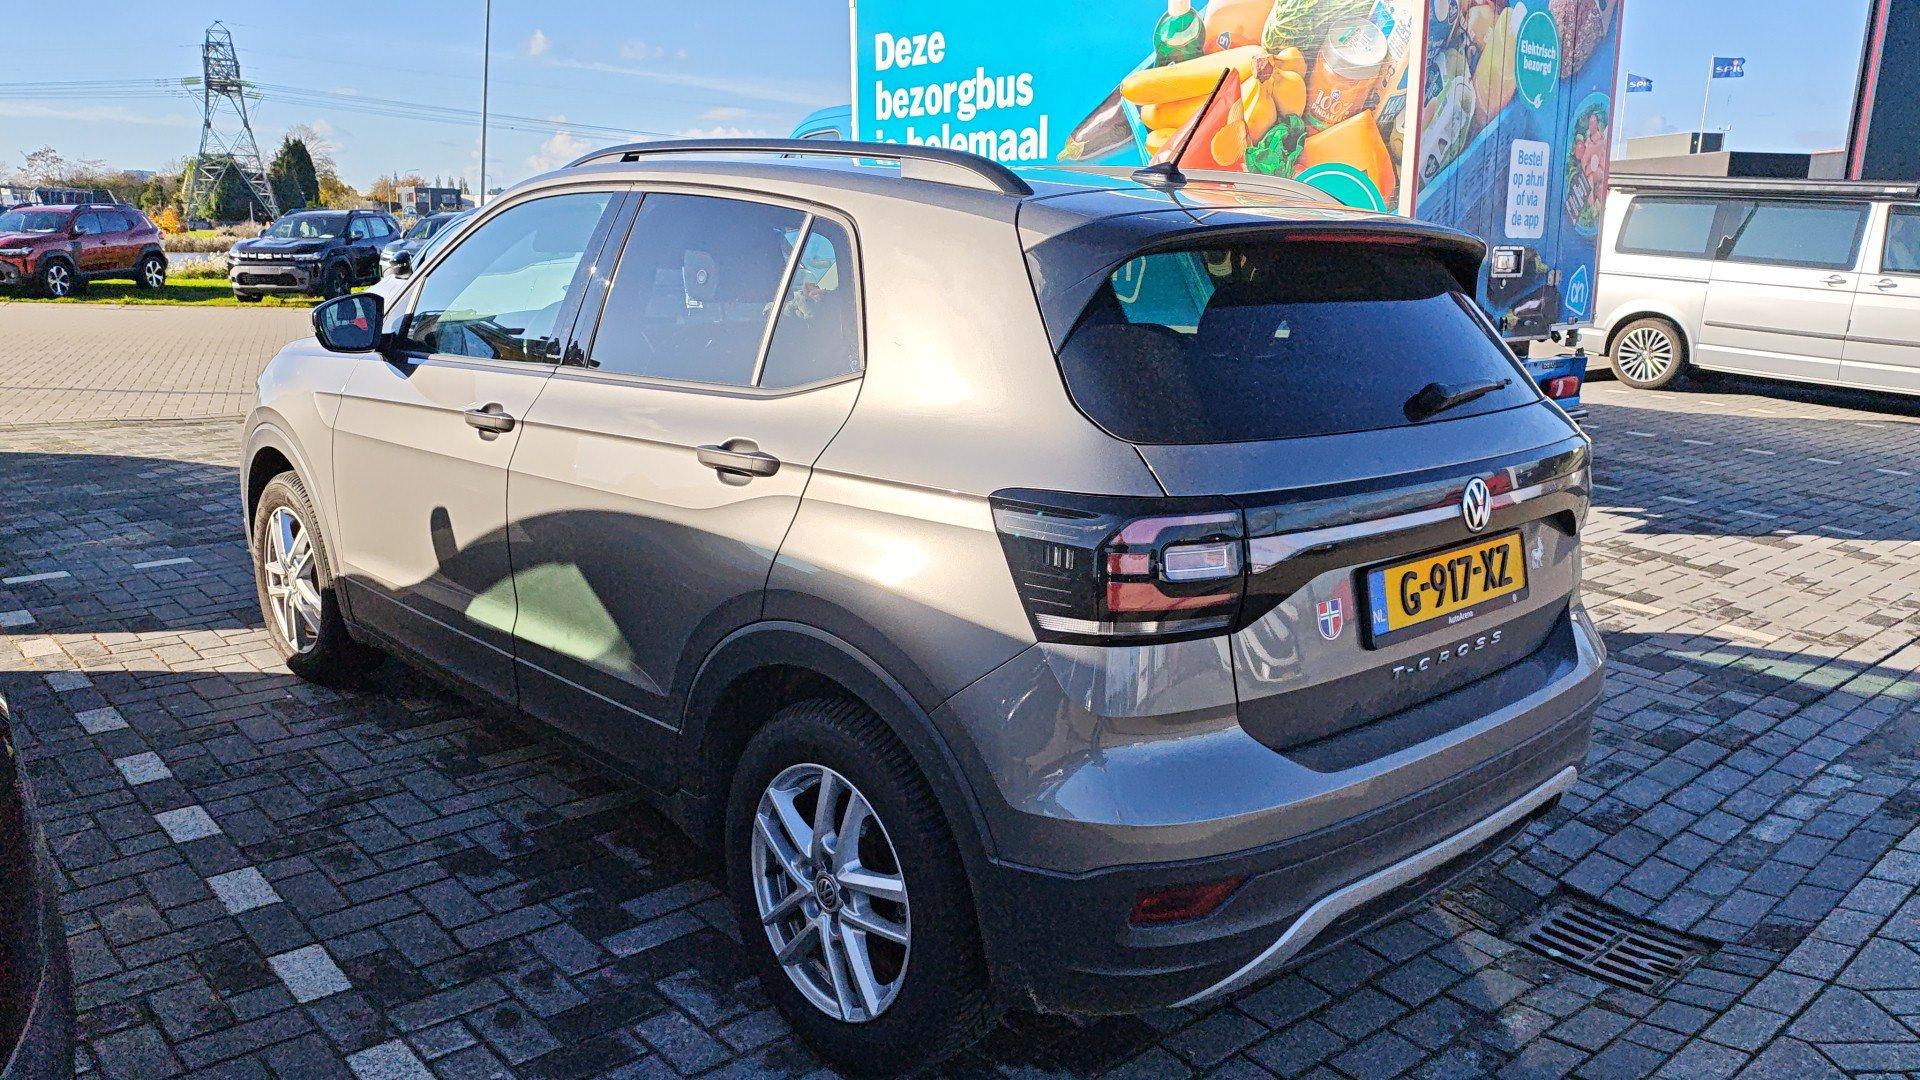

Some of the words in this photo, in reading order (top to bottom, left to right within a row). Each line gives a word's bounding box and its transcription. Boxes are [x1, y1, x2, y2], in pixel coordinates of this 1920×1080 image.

[874, 30, 946, 71] Deze
[1520, 40, 1557, 59] Elektrisch
[1523, 56, 1552, 75] bezorgd
[874, 66, 1034, 122] bezorgbus
[1518, 149, 1543, 167] Bestel
[1513, 173, 1523, 188] op
[1525, 170, 1545, 186] ah.nl
[1516, 190, 1526, 206] of
[1527, 191, 1538, 206] via
[1511, 210, 1522, 226] de
[1523, 213, 1539, 230] app
[1399, 543, 1513, 617] G-917-XZ
[1372, 608, 1387, 624] NL
[1391, 630, 1502, 681] T-CROSS
